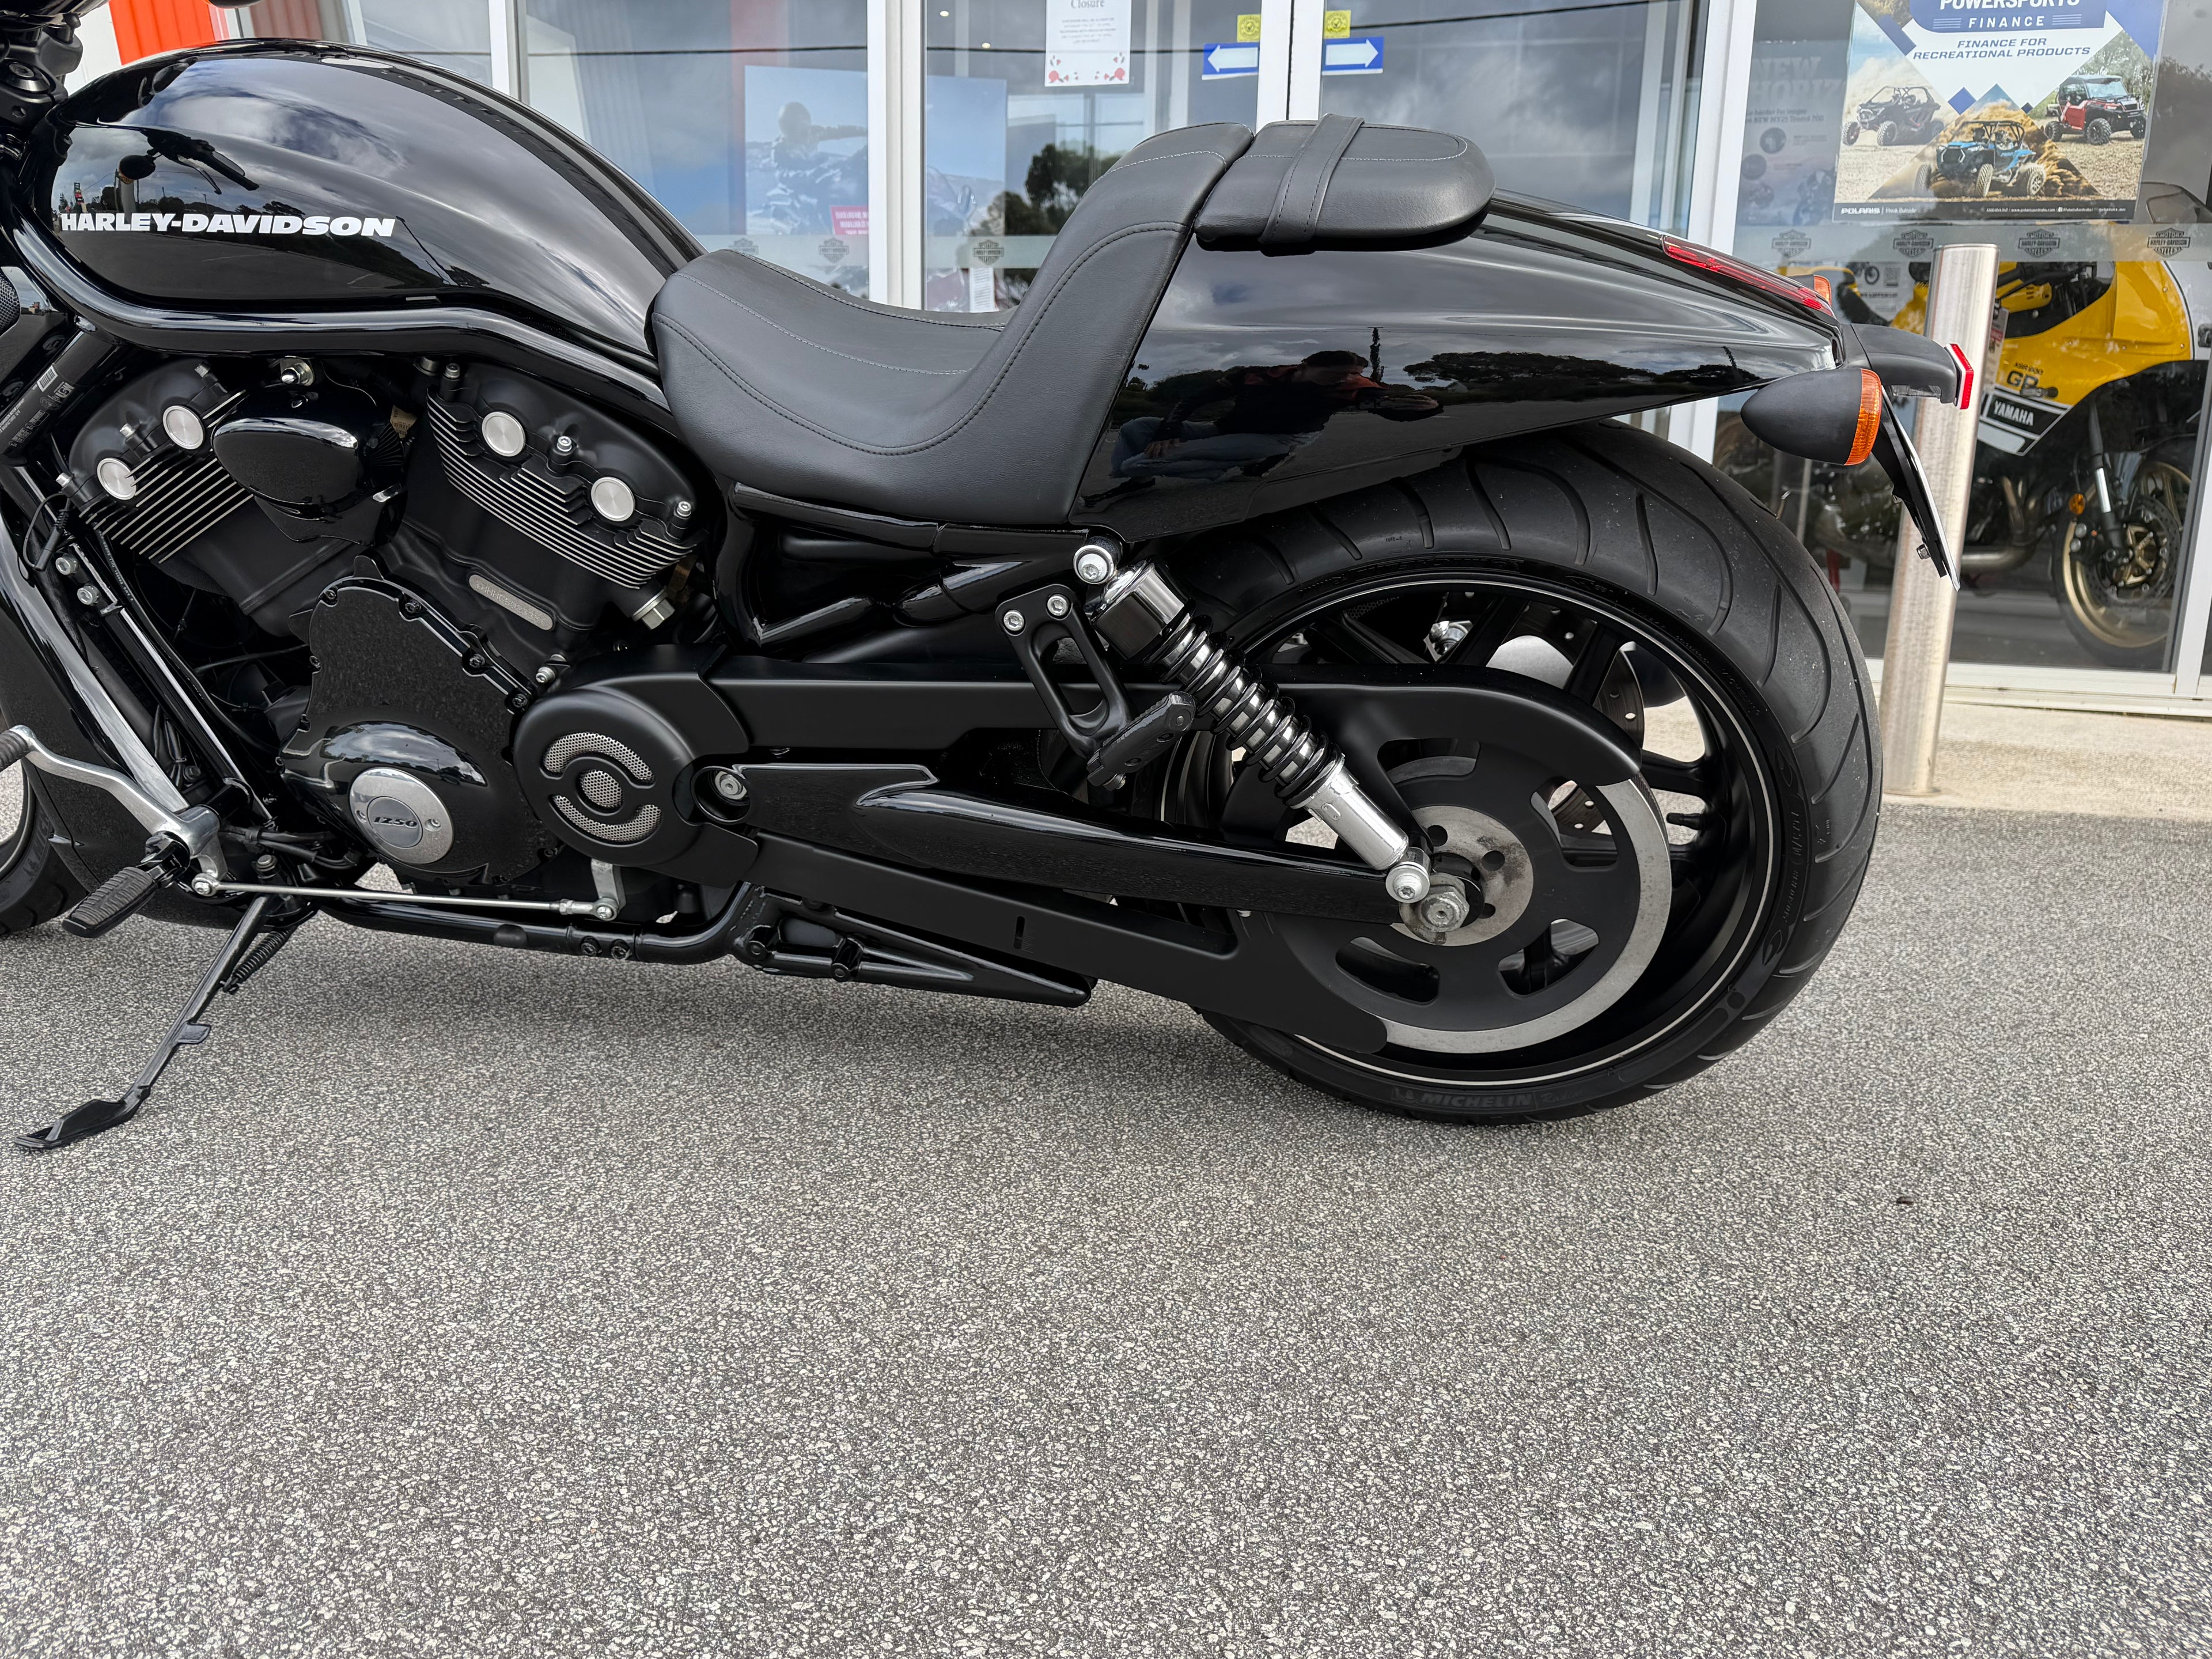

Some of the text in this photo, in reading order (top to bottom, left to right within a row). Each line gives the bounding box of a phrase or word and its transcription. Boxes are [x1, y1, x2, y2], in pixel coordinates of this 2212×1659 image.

[1968, 16, 2045, 28] FINANCE
[1957, 37, 2047, 48] FINANCE FOR
[1913, 47, 2091, 60] RECREATIONAL PRODUCTS
[60, 213, 396, 237] HARLEY-DAVIDSON
[1993, 400, 2035, 427] YAMAHA
[373, 816, 418, 828] 1250
[1420, 1093, 1533, 1108] MICHELIN
